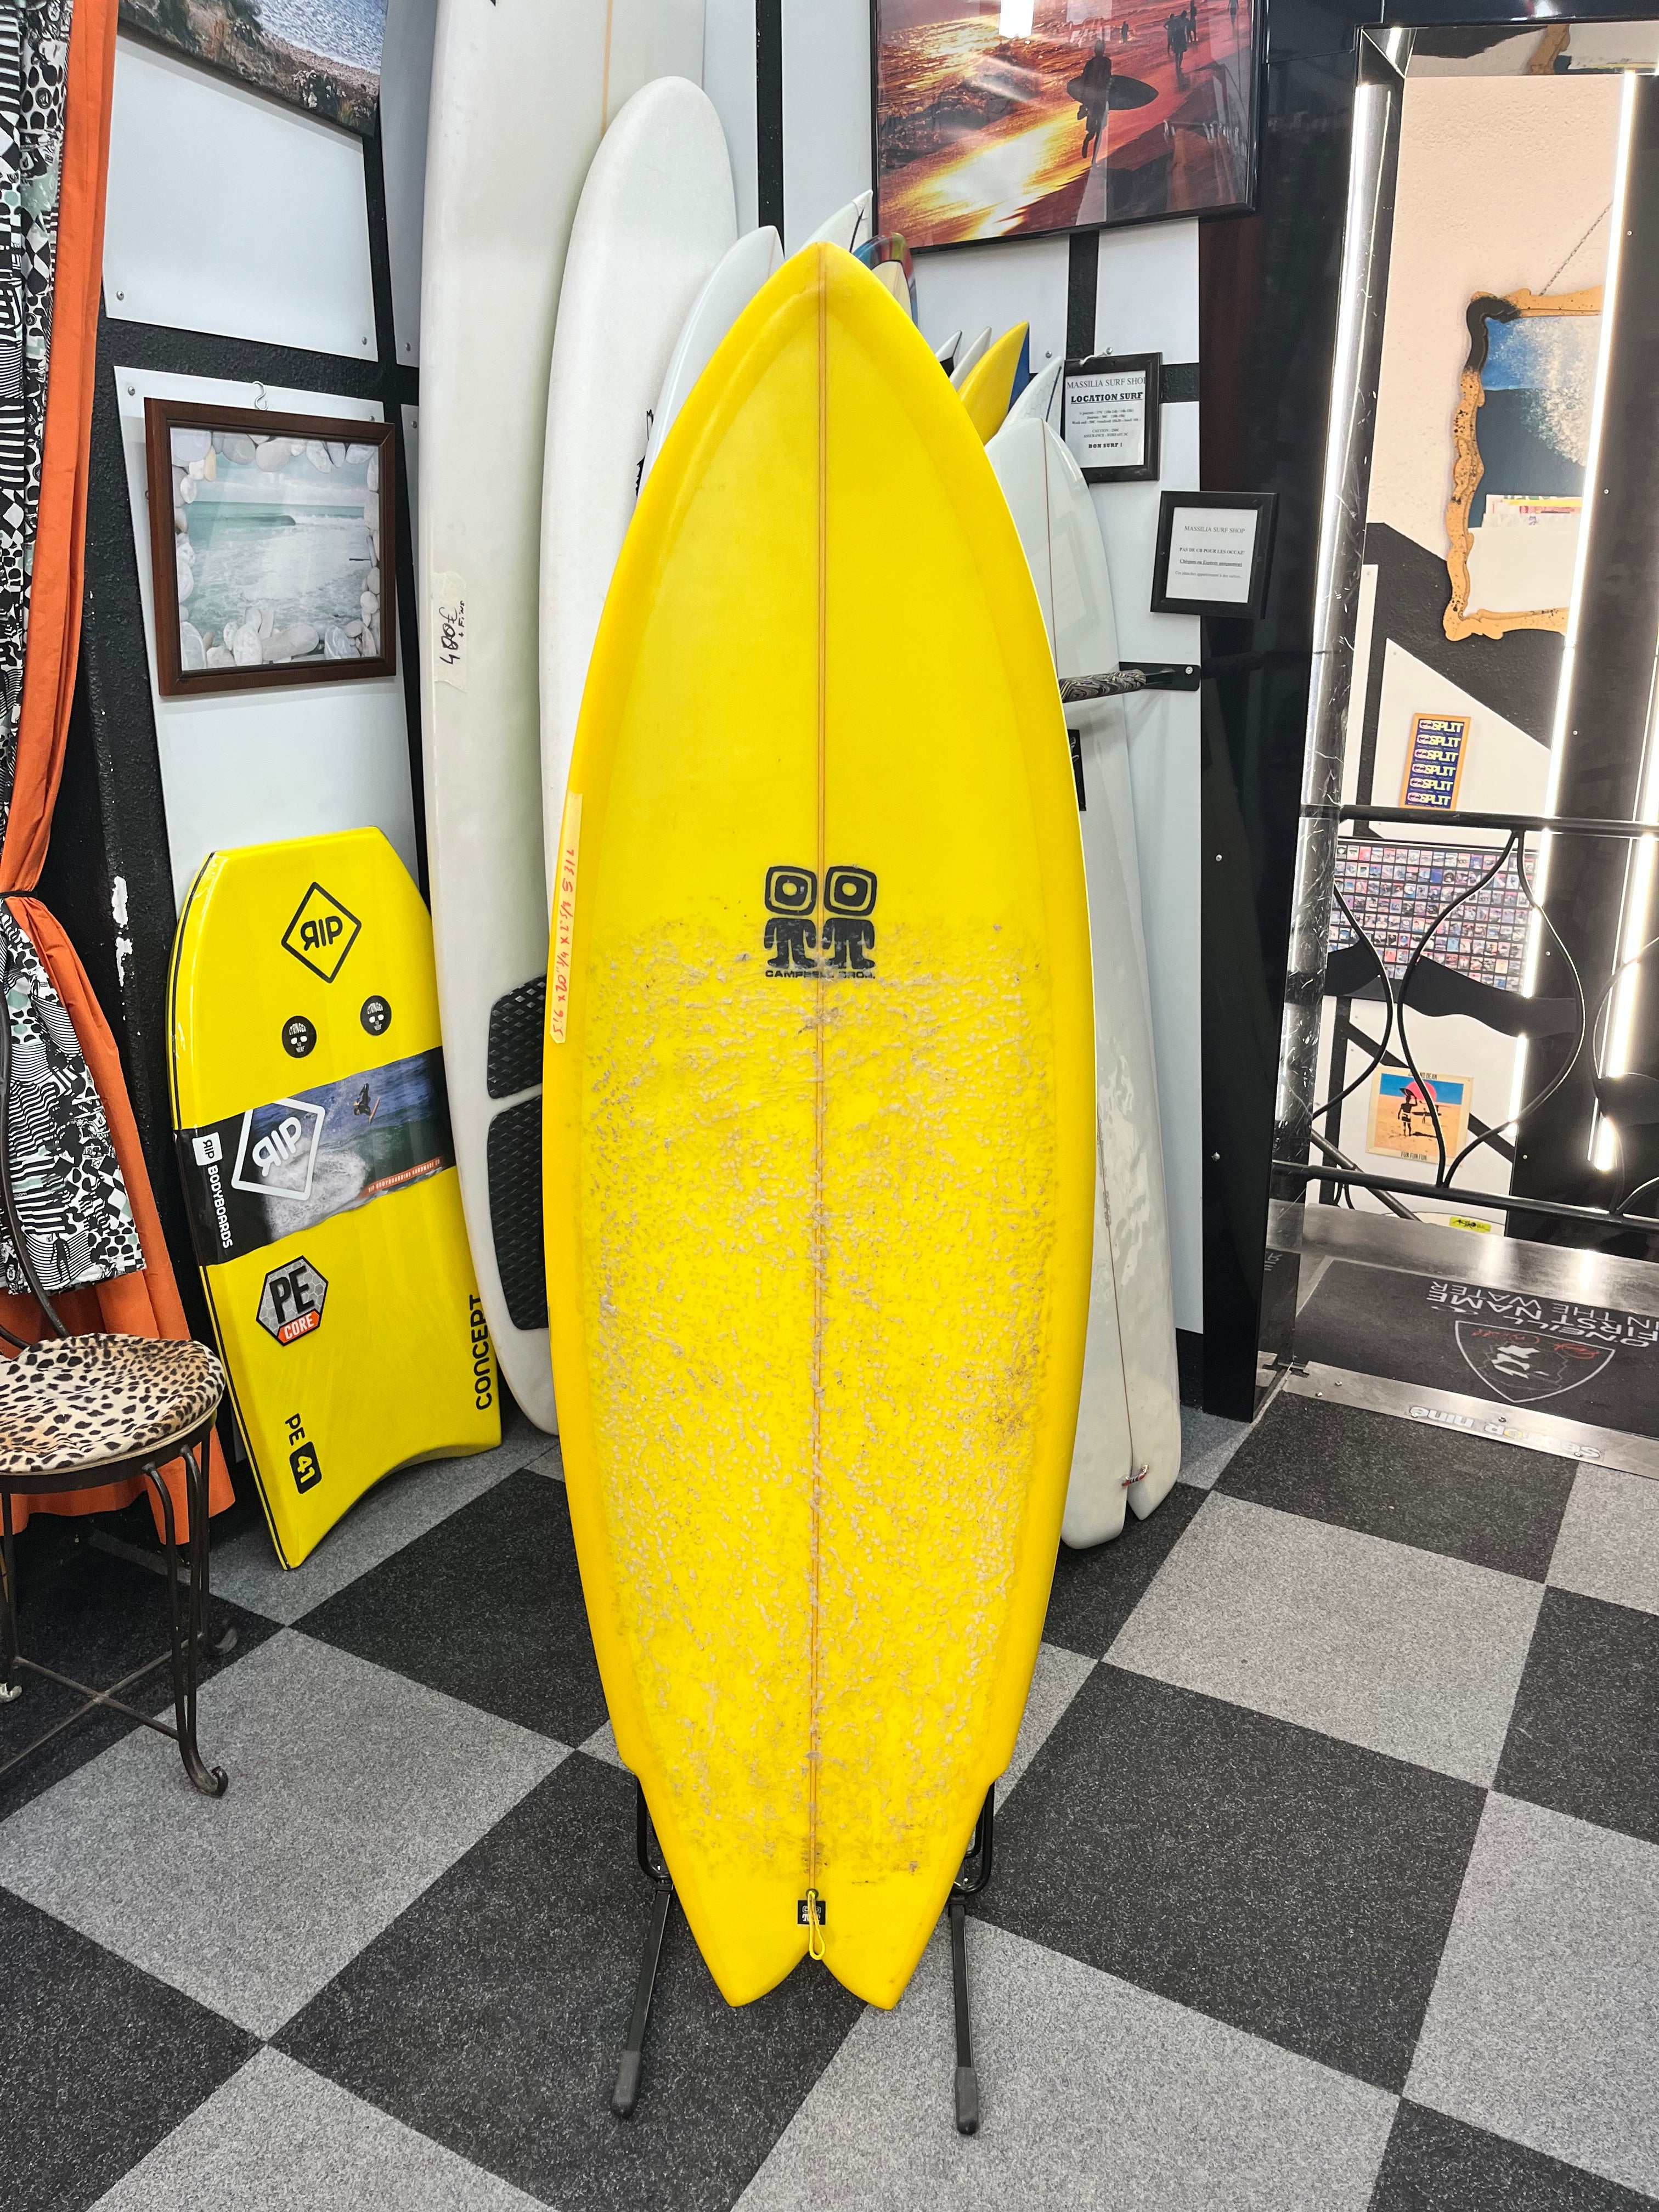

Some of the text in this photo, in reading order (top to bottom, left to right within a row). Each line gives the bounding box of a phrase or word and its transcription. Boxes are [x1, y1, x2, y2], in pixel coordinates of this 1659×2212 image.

[1067, 380, 1103, 389] MASSILIA
[1071, 393, 1118, 403] LOCATION
[1432, 721, 1464, 733] SPLIT
[1430, 735, 1461, 748] SPLIT
[1427, 750, 1458, 762] SPLIT
[1426, 764, 1456, 777] SPLIT
[1424, 778, 1454, 791] SPLIT
[1421, 793, 1451, 806] SPLIT
[412, 1164, 434, 1175] HARDWARE
[208, 1165, 233, 1249] BODYBOARDS
[269, 1265, 315, 1324] PE
[1431, 1281, 1542, 1310] WATER
[1426, 1290, 1542, 1321] NAME
[1551, 1302, 1617, 1323] THE
[284, 1313, 314, 1340] CORE
[1503, 1315, 1650, 1348] O'NEILL
[1551, 1314, 1658, 1342] FIRST
[285, 1413, 315, 1483] PE 41
